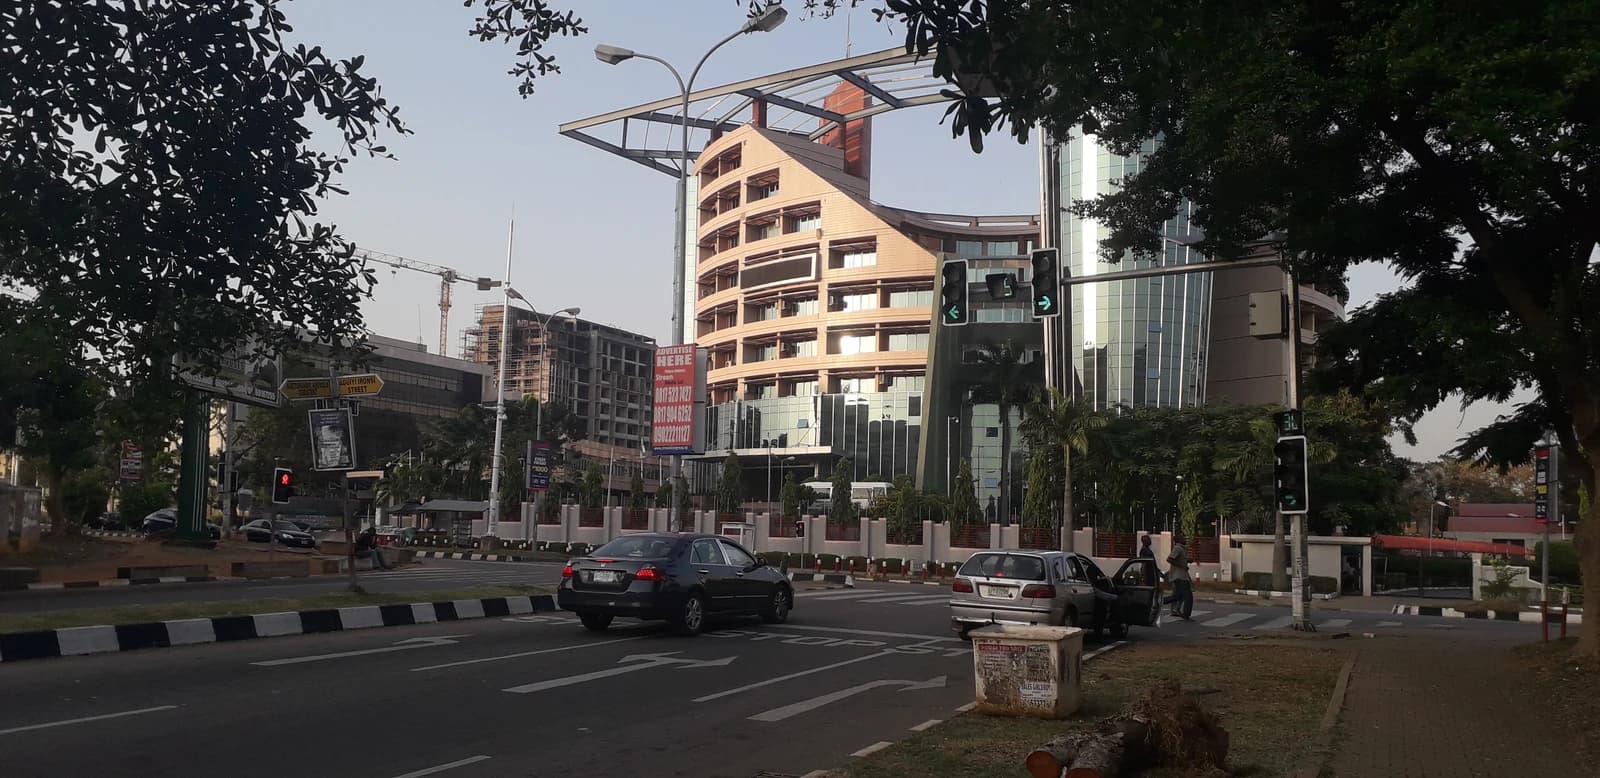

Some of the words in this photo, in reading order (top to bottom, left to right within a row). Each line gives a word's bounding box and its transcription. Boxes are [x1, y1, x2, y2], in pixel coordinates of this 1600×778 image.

[656, 354, 692, 367] HERE
[347, 385, 367, 393] STREET
[705, 630, 888, 647] STOP
